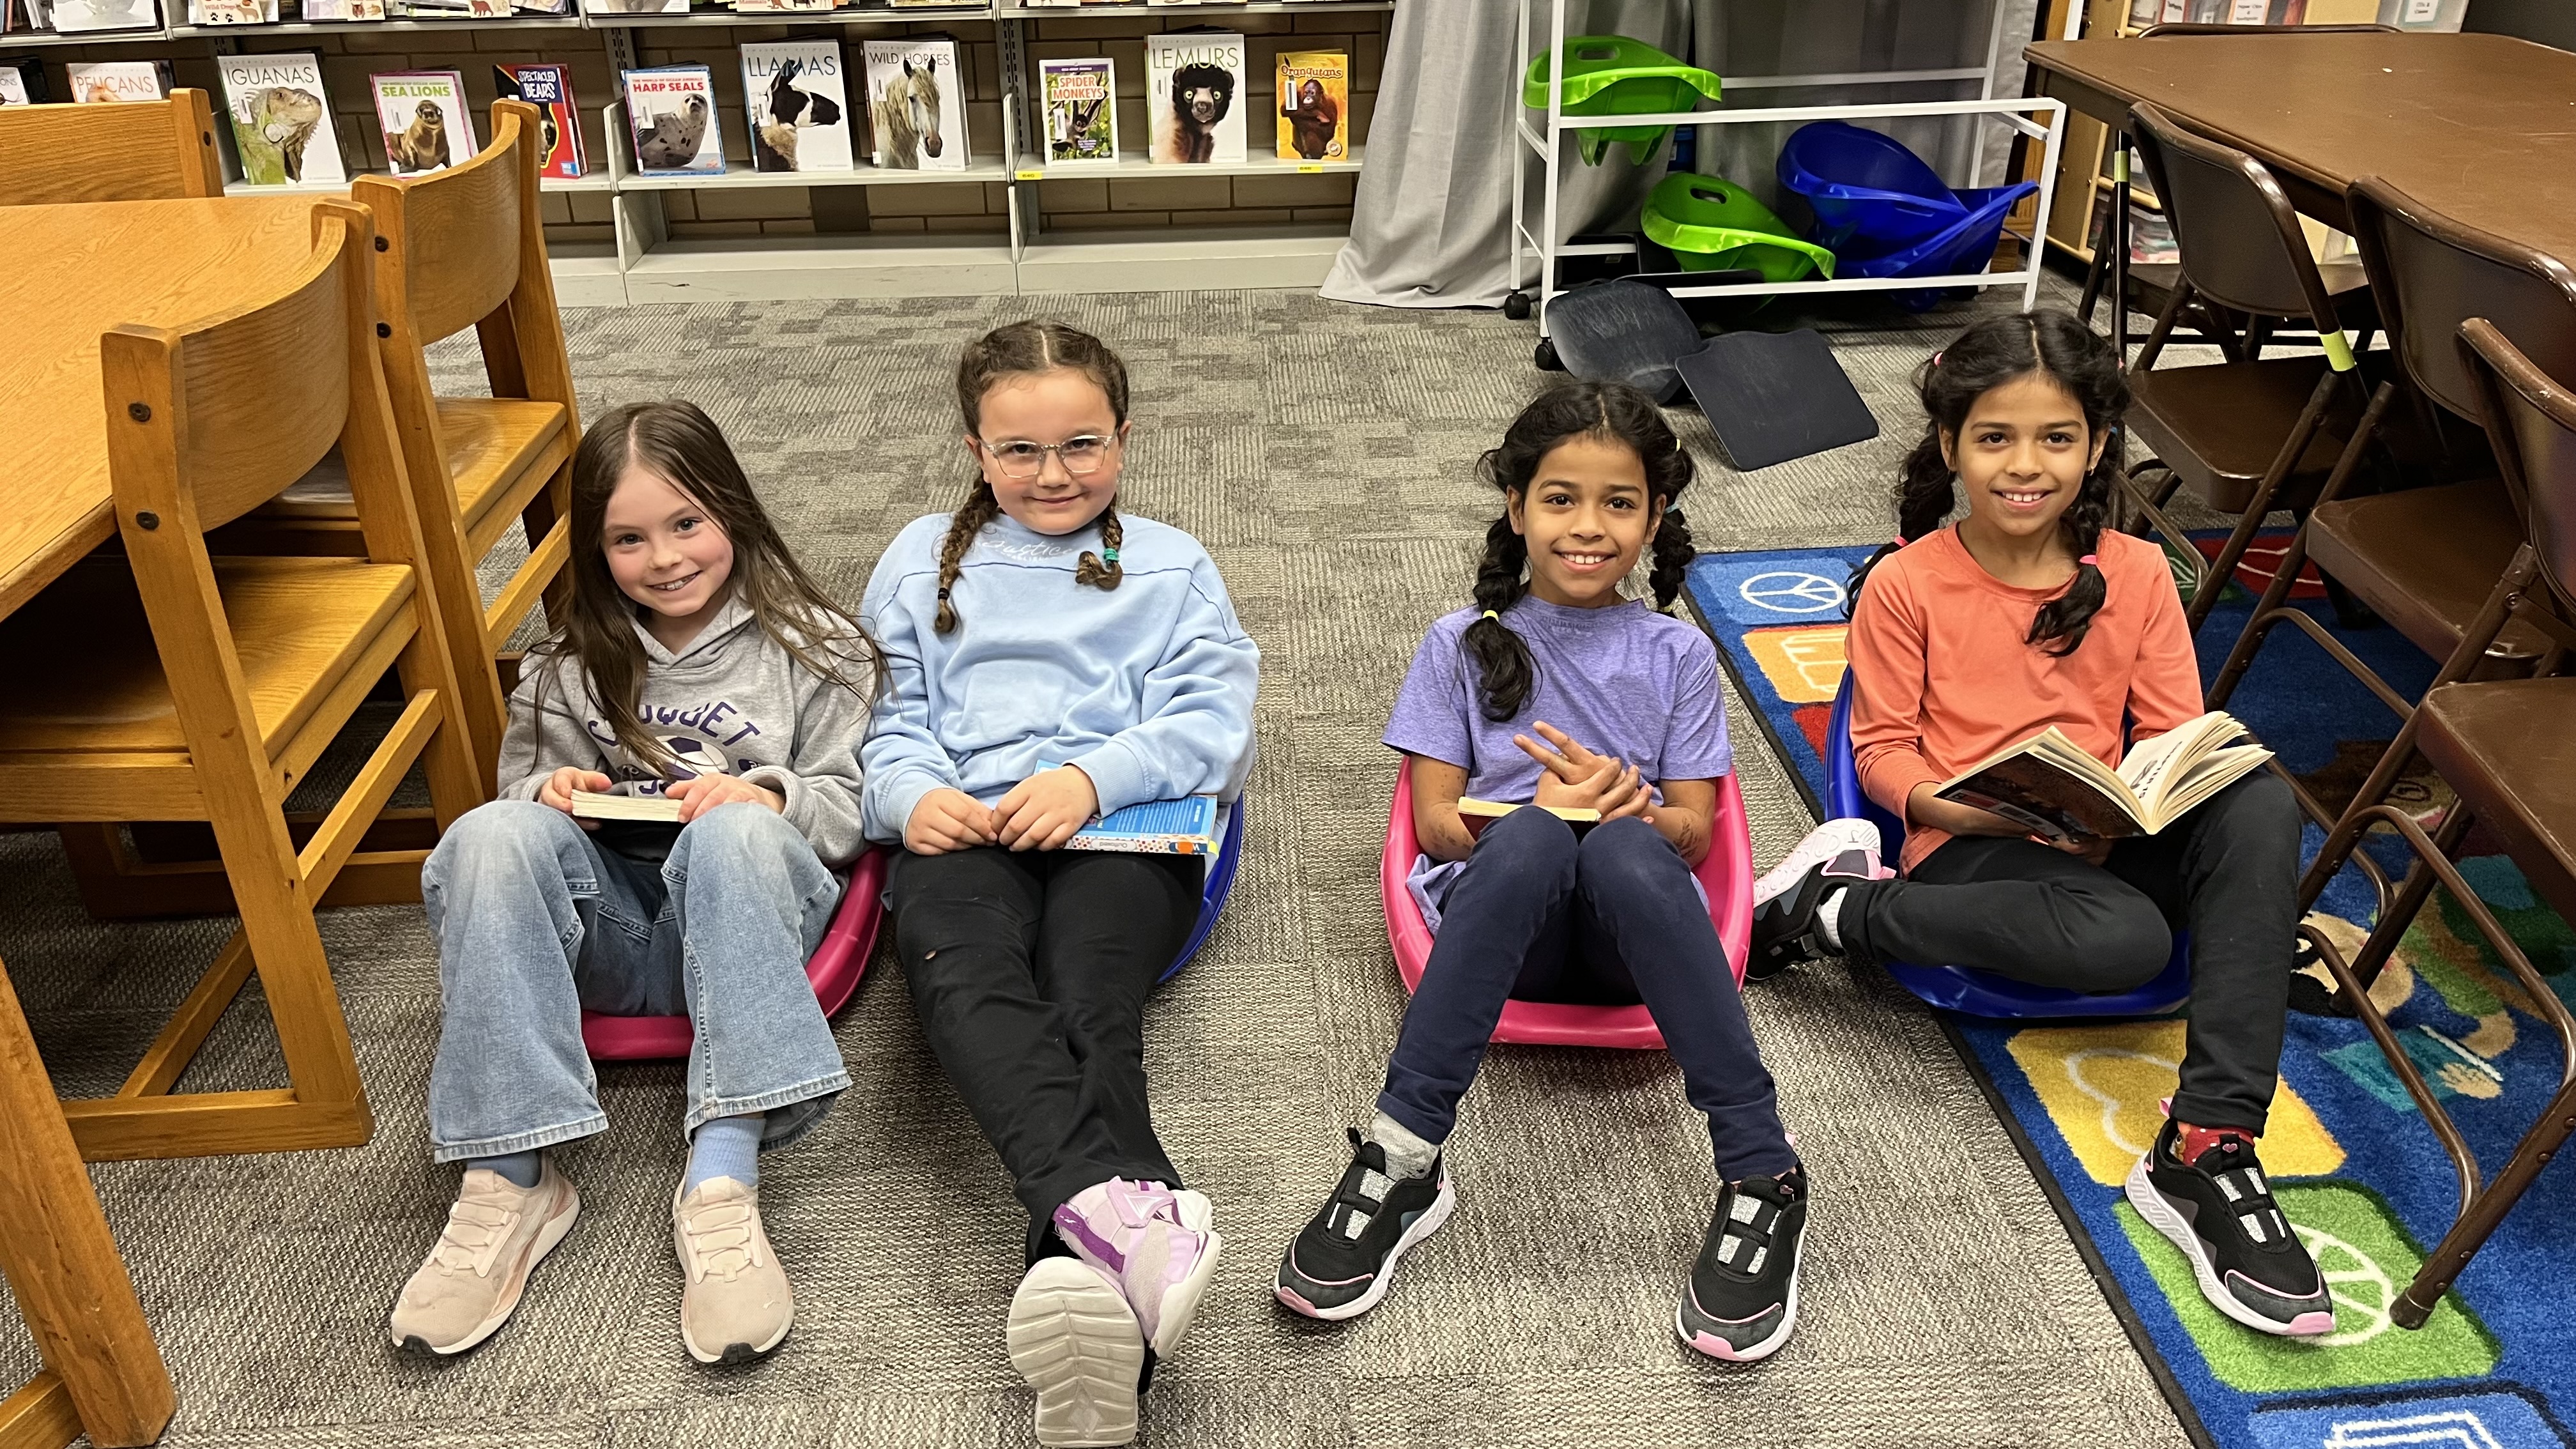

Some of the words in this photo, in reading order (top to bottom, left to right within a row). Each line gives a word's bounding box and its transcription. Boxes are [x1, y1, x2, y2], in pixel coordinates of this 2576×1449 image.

[869, 52, 899, 64] WILD
[1153, 47, 1238, 69] LEMURS
[747, 56, 836, 76] LLAMAS
[1282, 65, 1342, 79] Orangutans
[226, 66, 315, 86] IGUANAS
[518, 70, 556, 82] SPECTACLED
[1060, 77, 1095, 88] SPIDER
[76, 75, 154, 93] PELICANS
[523, 82, 556, 99] BEARS
[633, 83, 666, 93] HARP
[668, 82, 704, 91] SEALS
[381, 86, 409, 96] SEA
[410, 86, 450, 97] LIONS
[1053, 88, 1103, 100] MONKEYS
